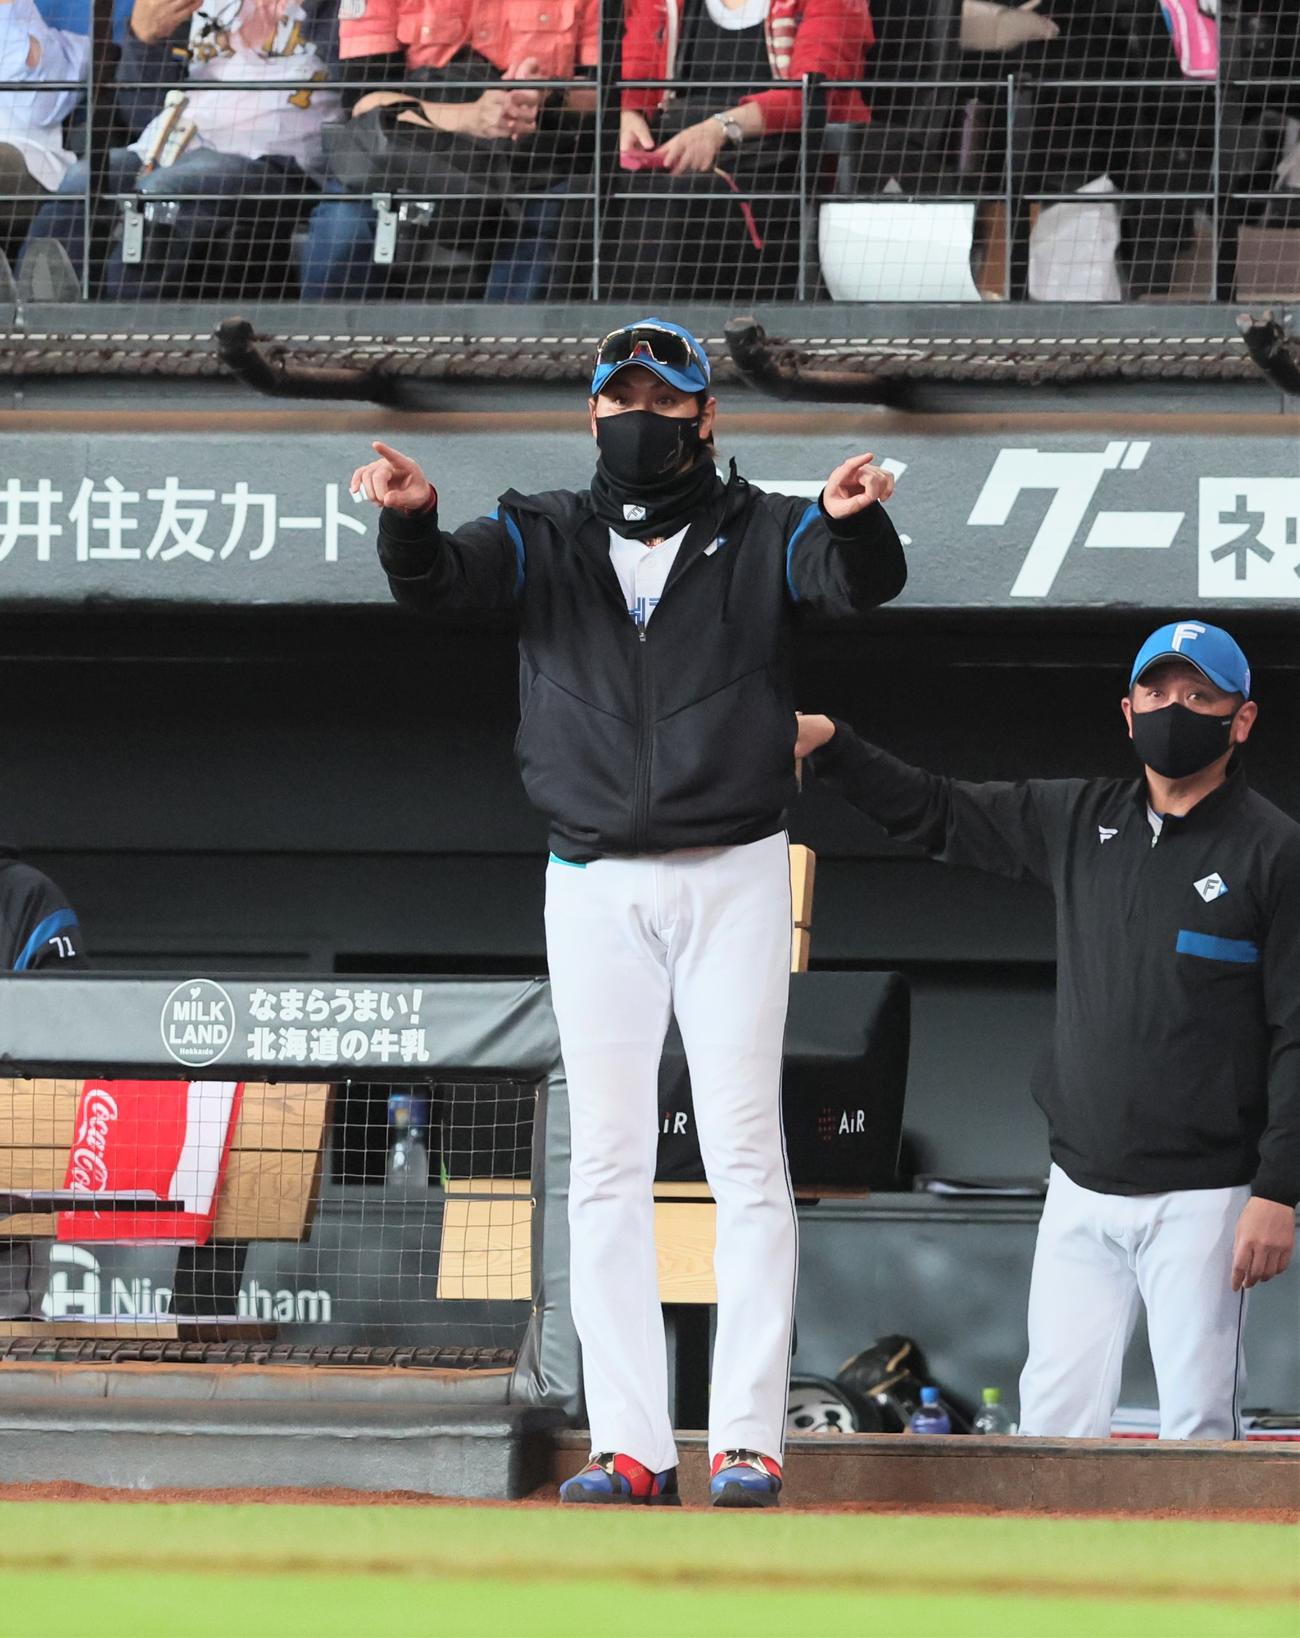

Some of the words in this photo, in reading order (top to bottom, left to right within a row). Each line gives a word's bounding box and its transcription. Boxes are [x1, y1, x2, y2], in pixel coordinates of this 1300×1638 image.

[1171, 624, 1206, 652] F
[48, 936, 76, 958] 71
[249, 988, 423, 1024] なまらうまい!
[170, 1024, 227, 1044] LAND
[247, 1027, 429, 1062] 北海道の牛乳
[657, 1112, 688, 1134] iR
